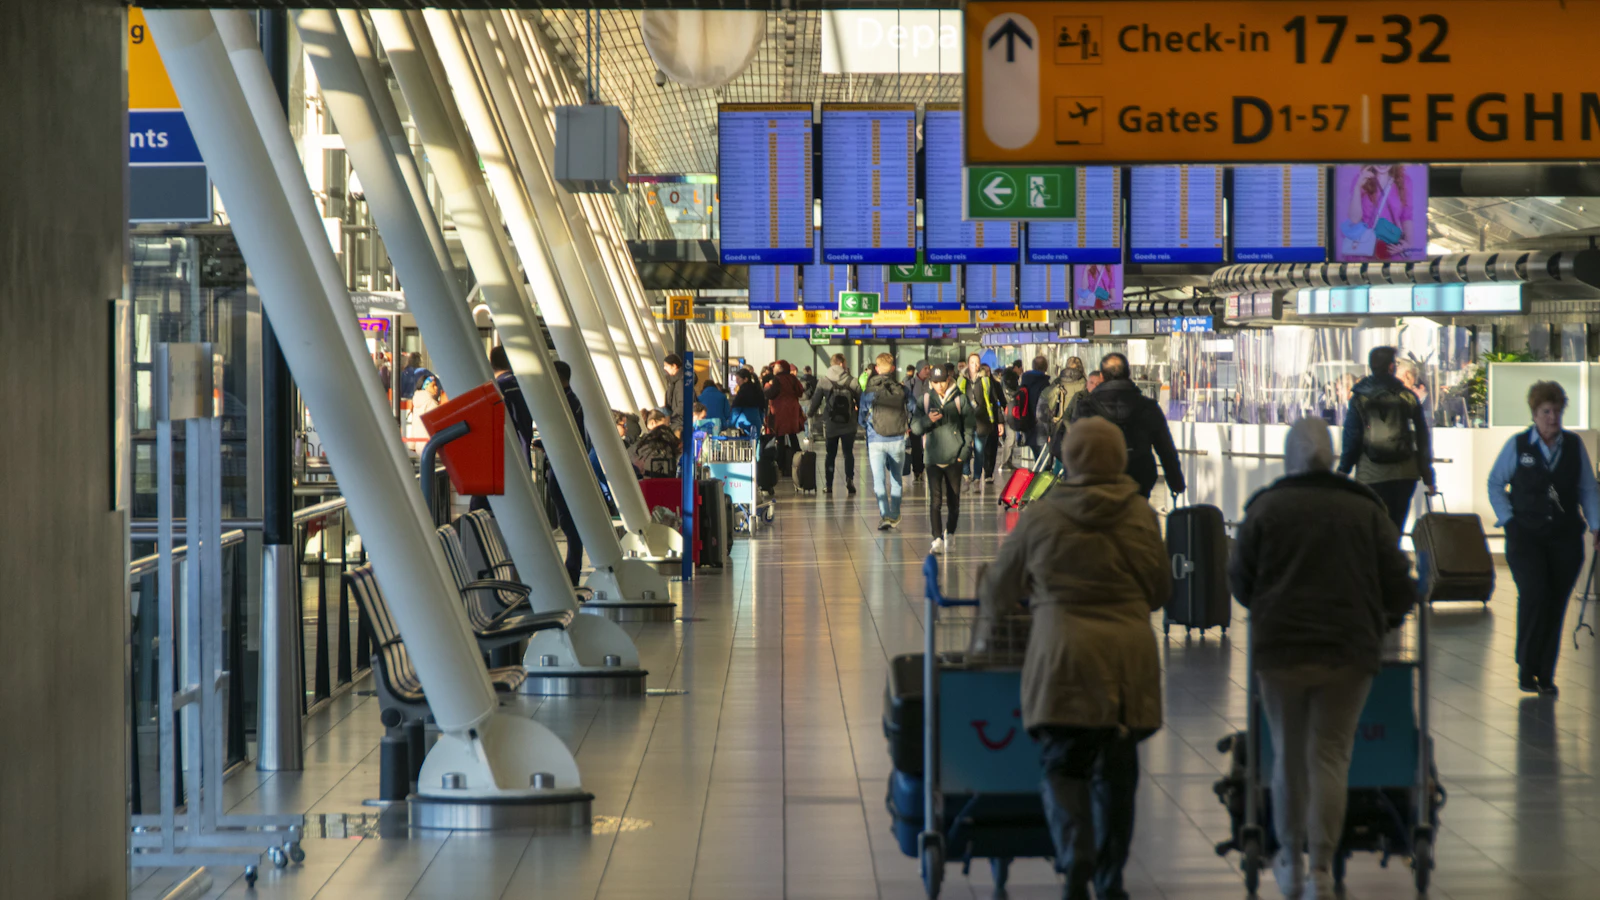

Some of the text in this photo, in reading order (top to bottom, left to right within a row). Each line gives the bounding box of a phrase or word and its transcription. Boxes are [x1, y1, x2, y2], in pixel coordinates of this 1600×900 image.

[1117, 14, 1451, 65] Check-in 17-32
[1117, 105, 1219, 133] Gates
[724, 253, 761, 262] Goede reis
[826, 253, 864, 261] Goede reis
[930, 252, 967, 260] Goede reis
[1032, 252, 1069, 260] Goede reis
[1134, 252, 1171, 260] Goede reis
[1237, 252, 1273, 260] Goede reis
[1000, 309, 1029, 319] Gates M
